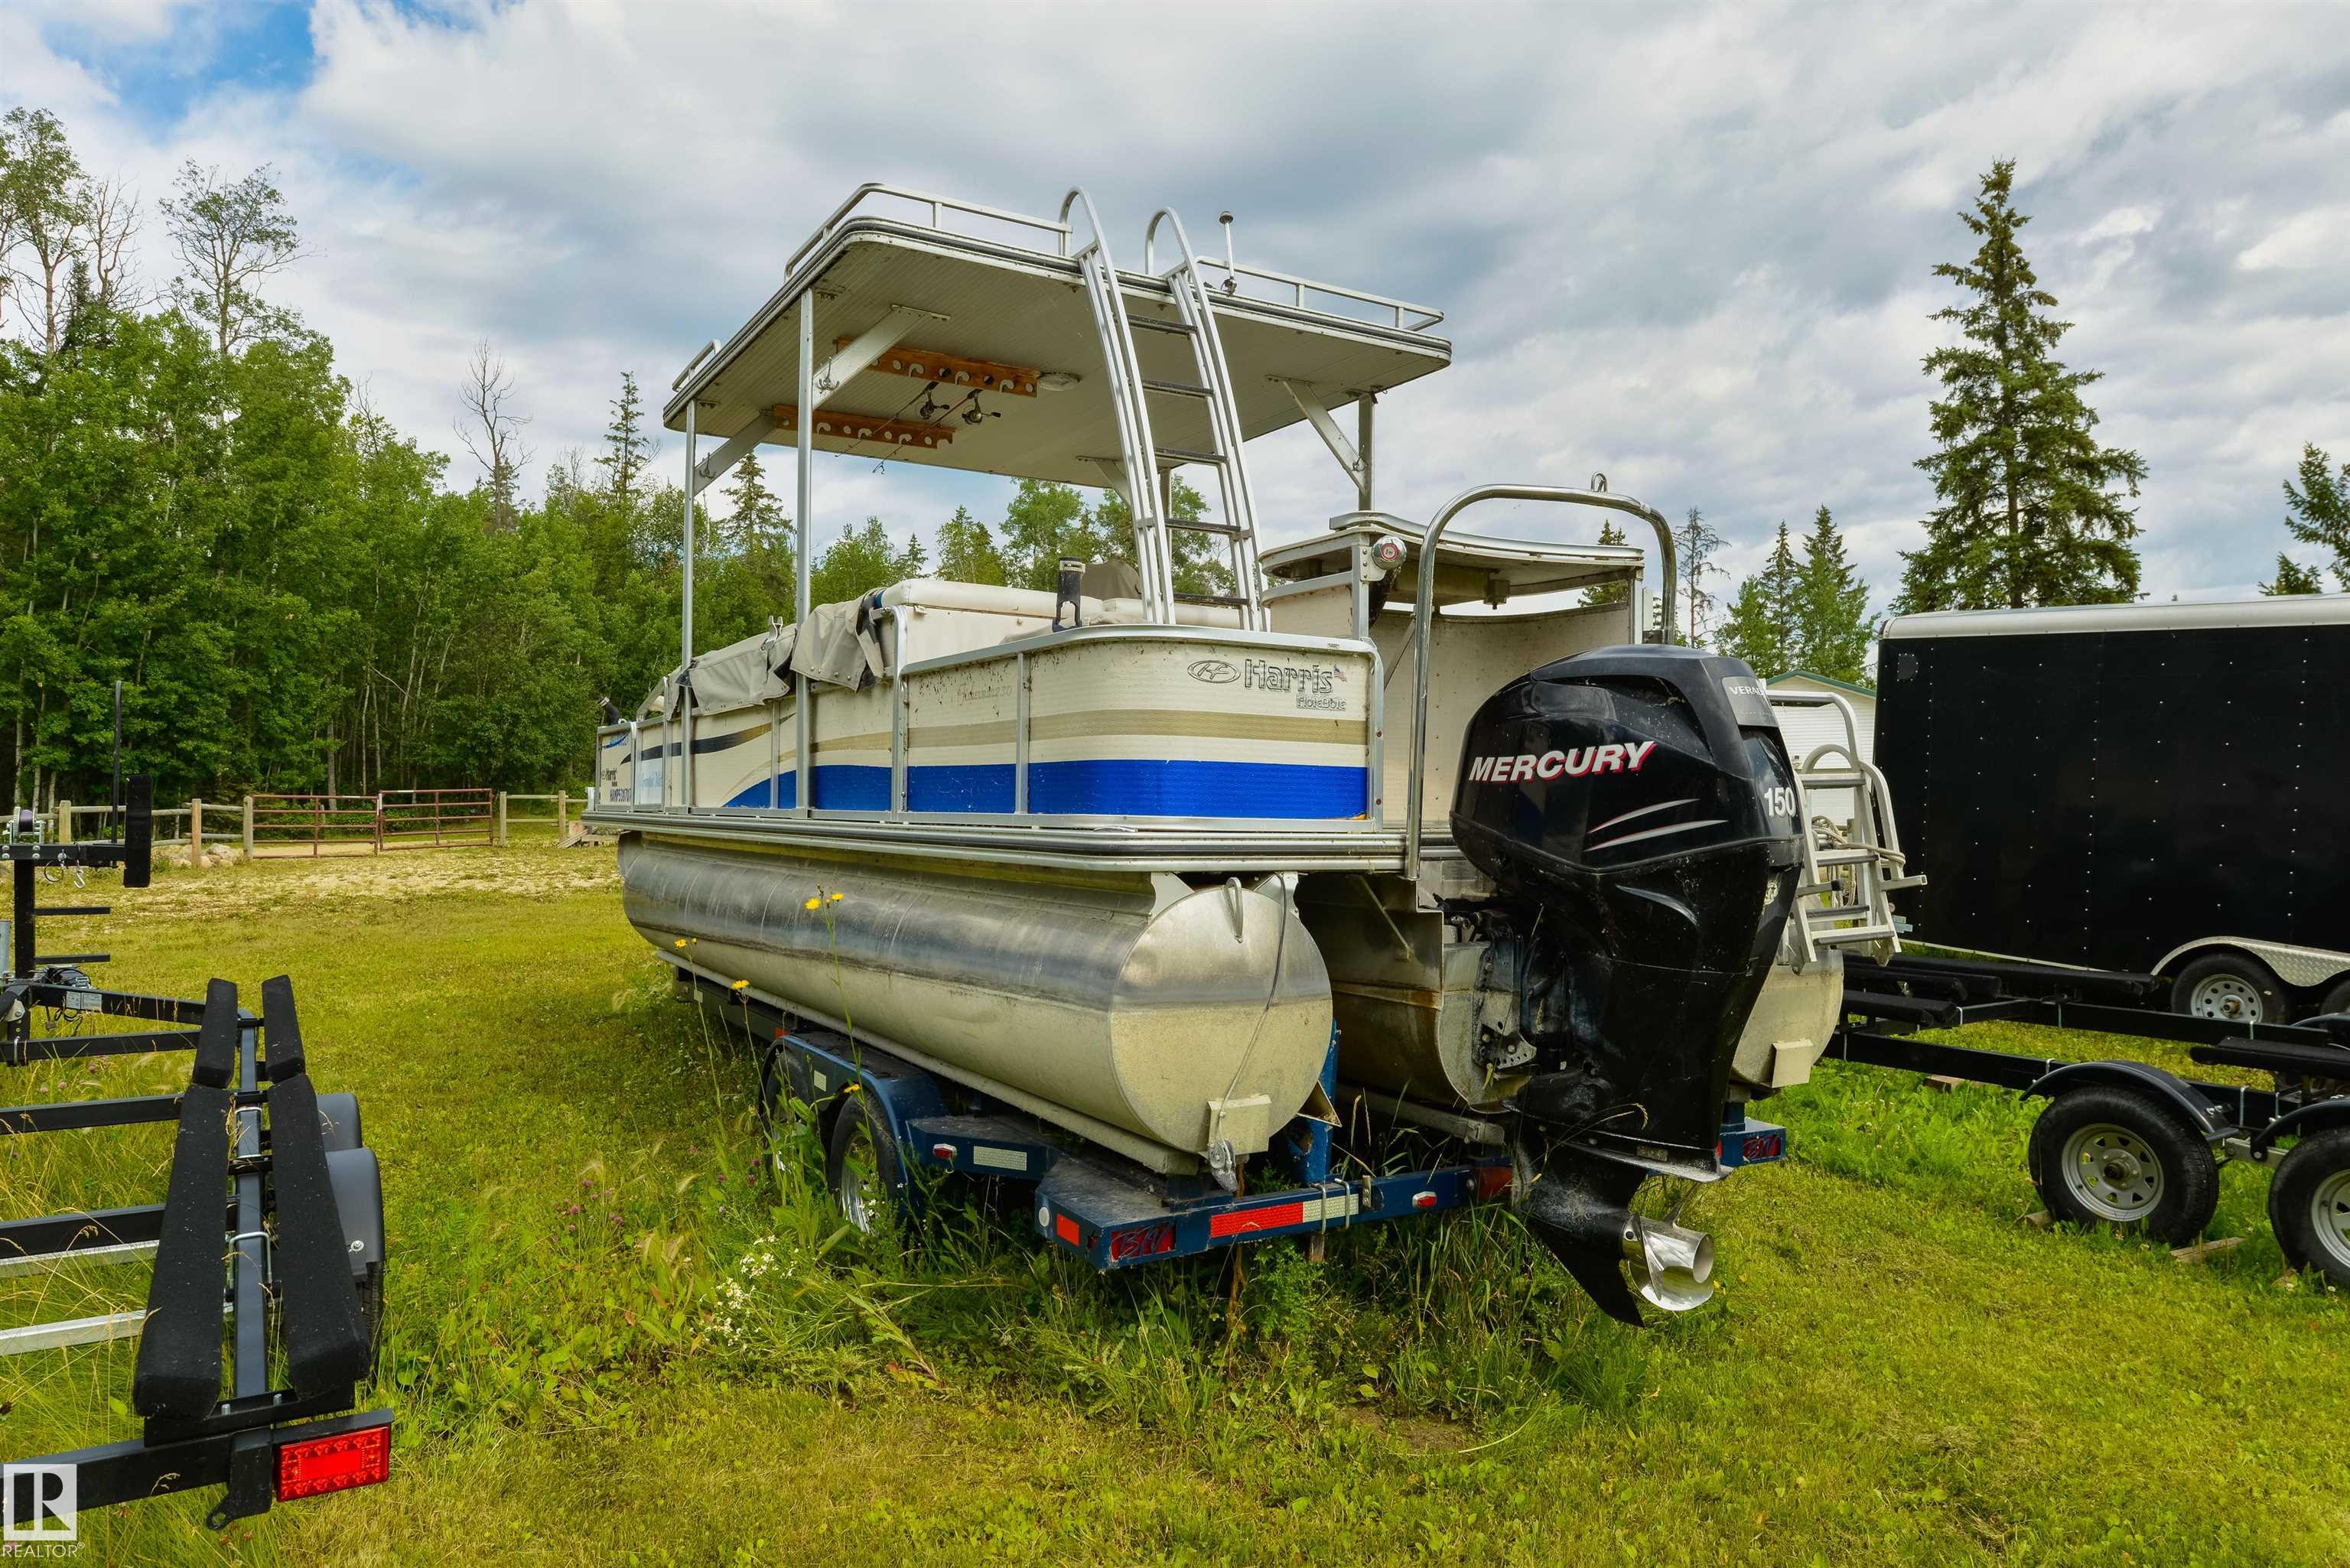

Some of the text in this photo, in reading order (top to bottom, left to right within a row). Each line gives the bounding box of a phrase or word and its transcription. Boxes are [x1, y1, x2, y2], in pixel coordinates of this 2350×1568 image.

[1245, 659, 1333, 694] Harris
[1468, 740, 1658, 783] MERCURY
[1764, 787, 1797, 818] 150
